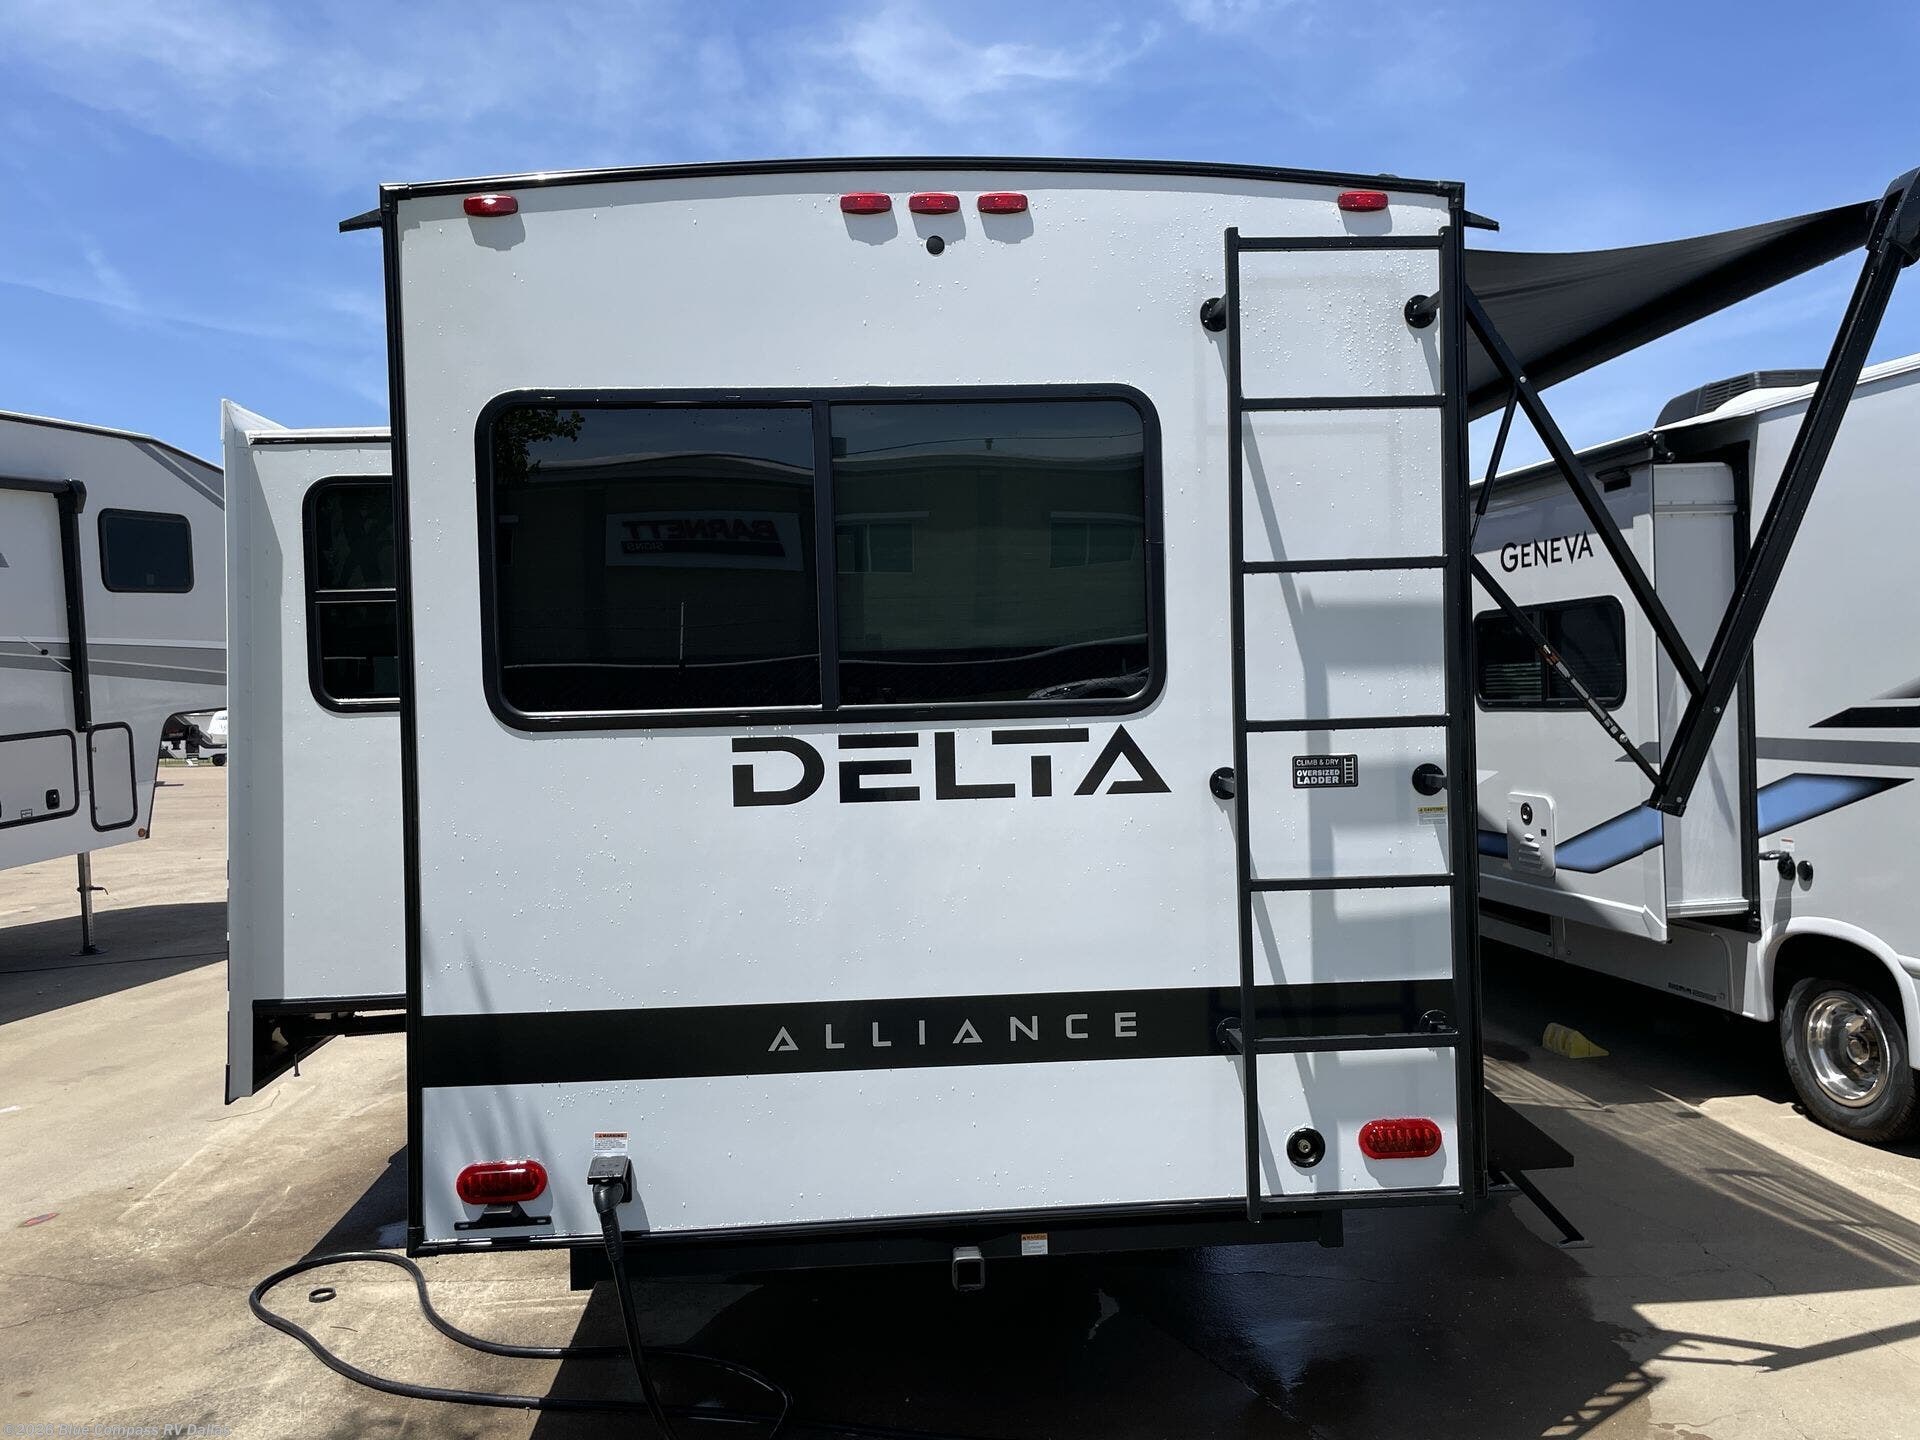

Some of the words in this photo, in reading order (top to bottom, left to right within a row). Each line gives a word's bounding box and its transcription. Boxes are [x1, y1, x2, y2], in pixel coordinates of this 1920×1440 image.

[1500, 531, 1594, 573] GENEVA
[731, 724, 1172, 807] DELTA
[1296, 769, 1340, 777] OVERSIZED
[1296, 776, 1340, 785] LADDER
[767, 1012, 1137, 1052] ALLIANCE
